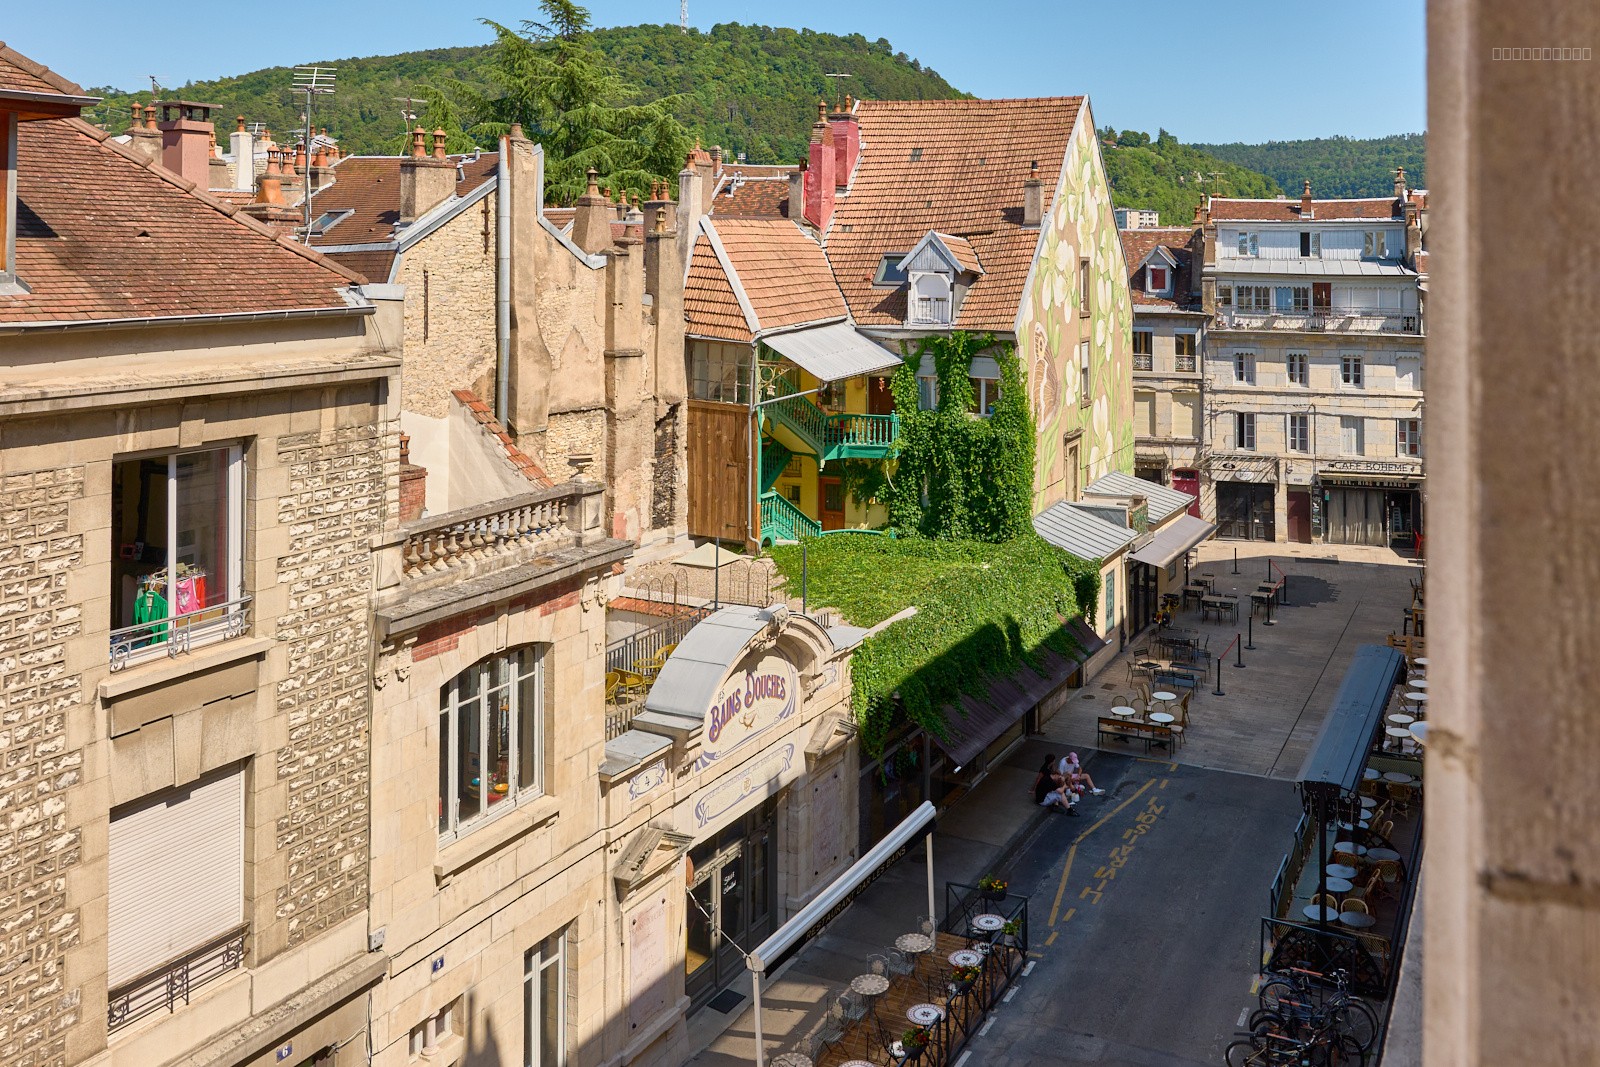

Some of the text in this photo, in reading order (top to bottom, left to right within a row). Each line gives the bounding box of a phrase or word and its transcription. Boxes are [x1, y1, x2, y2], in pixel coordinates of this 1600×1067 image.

[708, 671, 786, 743] BAINS DOUCHES
[805, 890, 857, 941] RESTAURANT
[873, 865, 886, 880] LES
[886, 845, 907, 869] BAINS
[282, 1046, 288, 1058] 6
